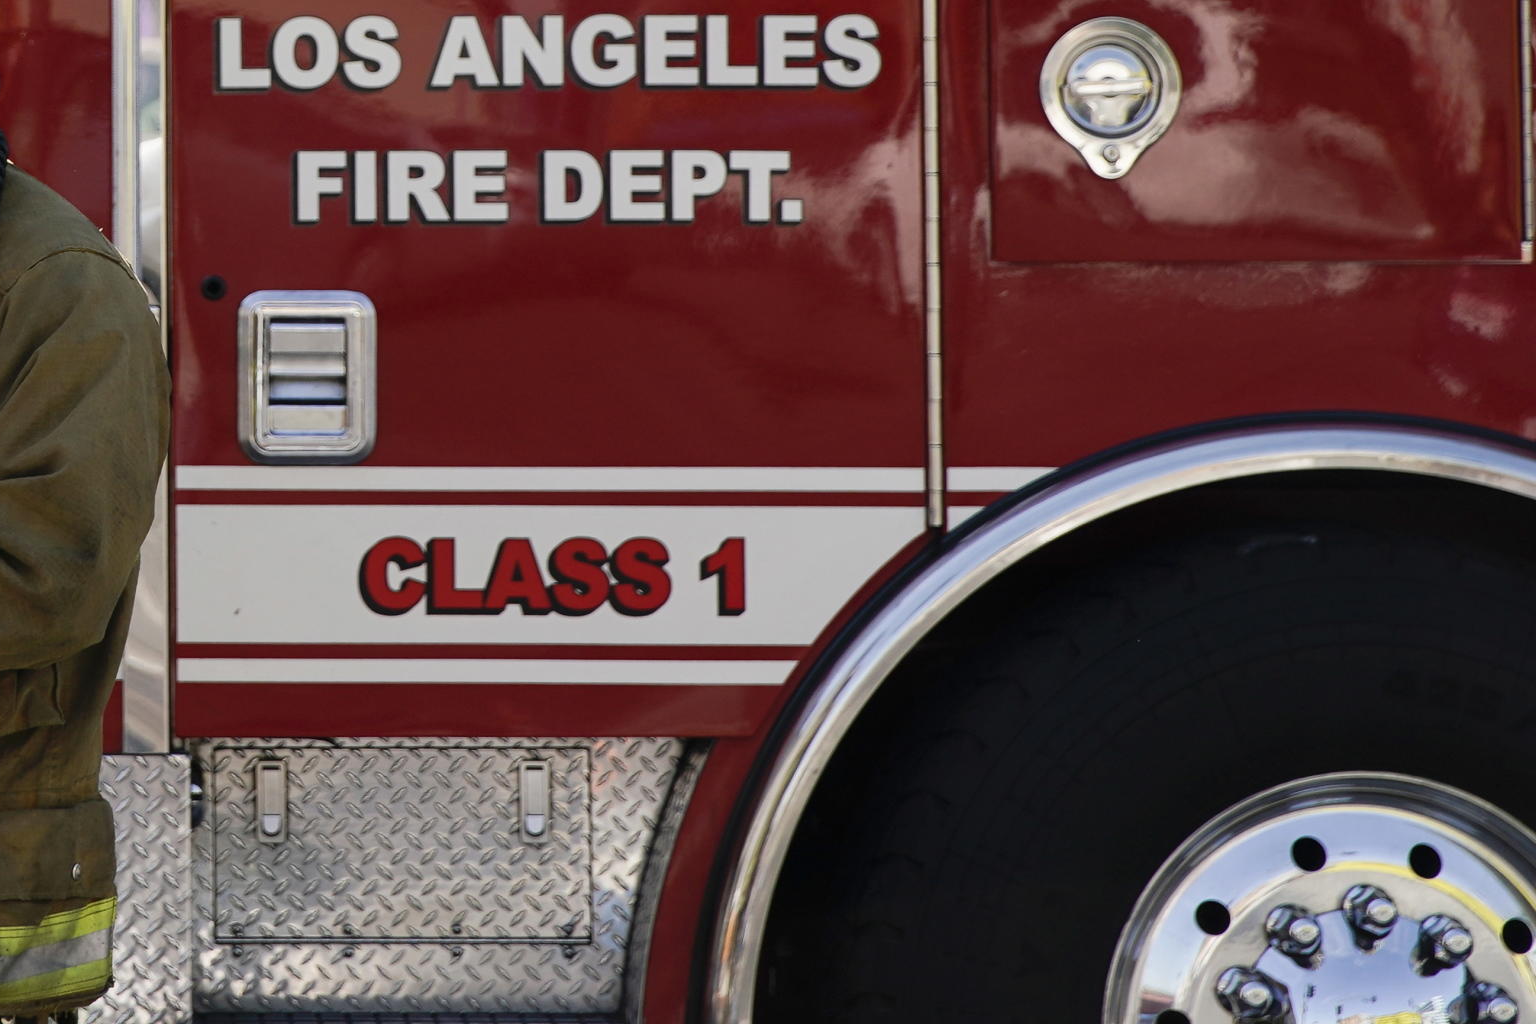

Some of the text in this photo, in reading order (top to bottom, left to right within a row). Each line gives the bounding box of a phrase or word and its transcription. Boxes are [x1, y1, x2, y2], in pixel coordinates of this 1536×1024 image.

[214, 13, 883, 93] LOS ANGELES
[292, 148, 805, 227] FIRE DEPT.
[358, 535, 747, 617] CLASS 1
